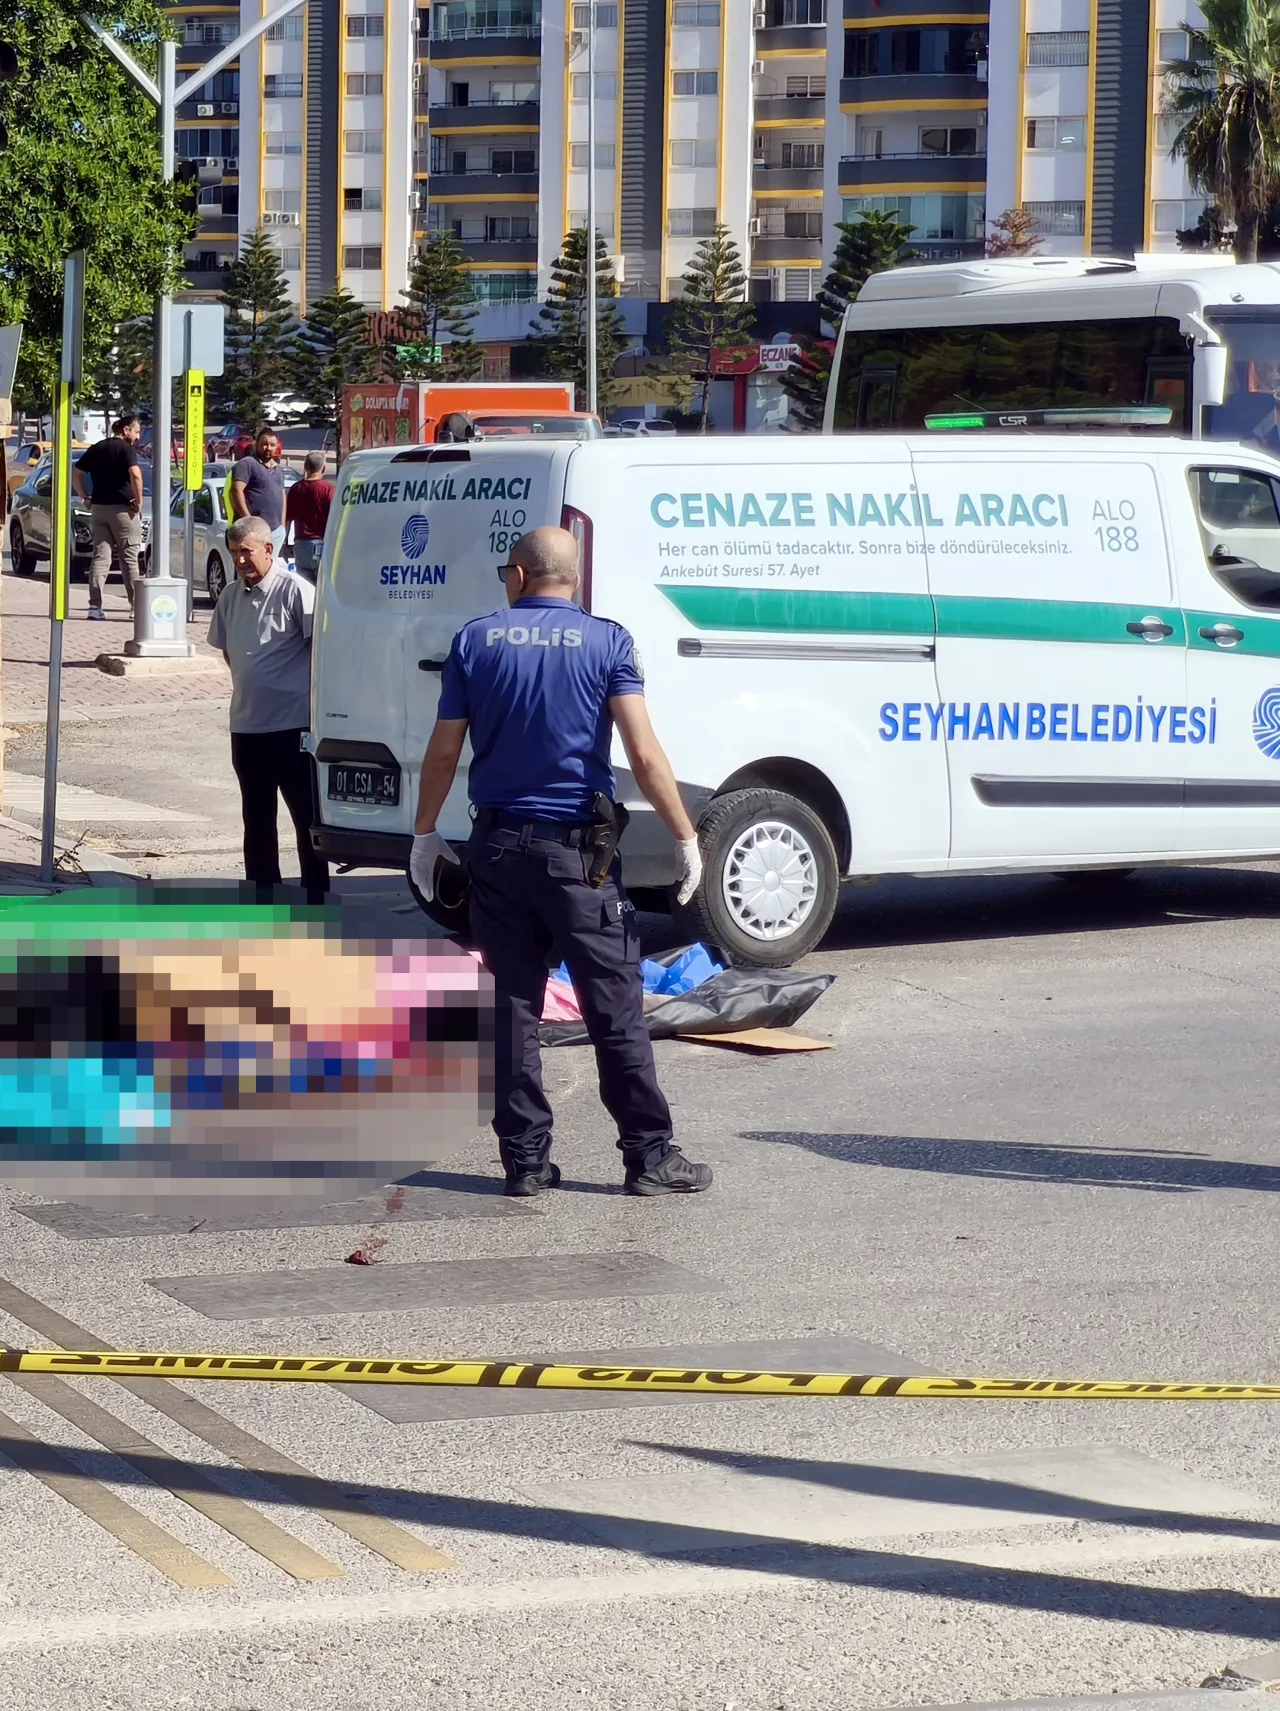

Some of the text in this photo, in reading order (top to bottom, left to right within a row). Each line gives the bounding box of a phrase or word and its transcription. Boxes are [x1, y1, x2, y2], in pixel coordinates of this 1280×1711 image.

[999, 416, 1028, 426] CSR
[341, 473, 531, 506] CENAZE NAKİL ARACI
[650, 484, 1069, 528] CENAZE NAKİL ARACI
[1092, 500, 1136, 521] ALO
[489, 509, 527, 528] ALO
[658, 539, 1073, 556] Her can ölümü tadacaktır. Sonra bize döndürüleceksiniz.
[1094, 526, 1140, 552] 188
[379, 564, 447, 586] SEYHAN
[659, 563, 821, 579] Ankebût Suresi 57. Ayet
[336, 771, 347, 792] 01
